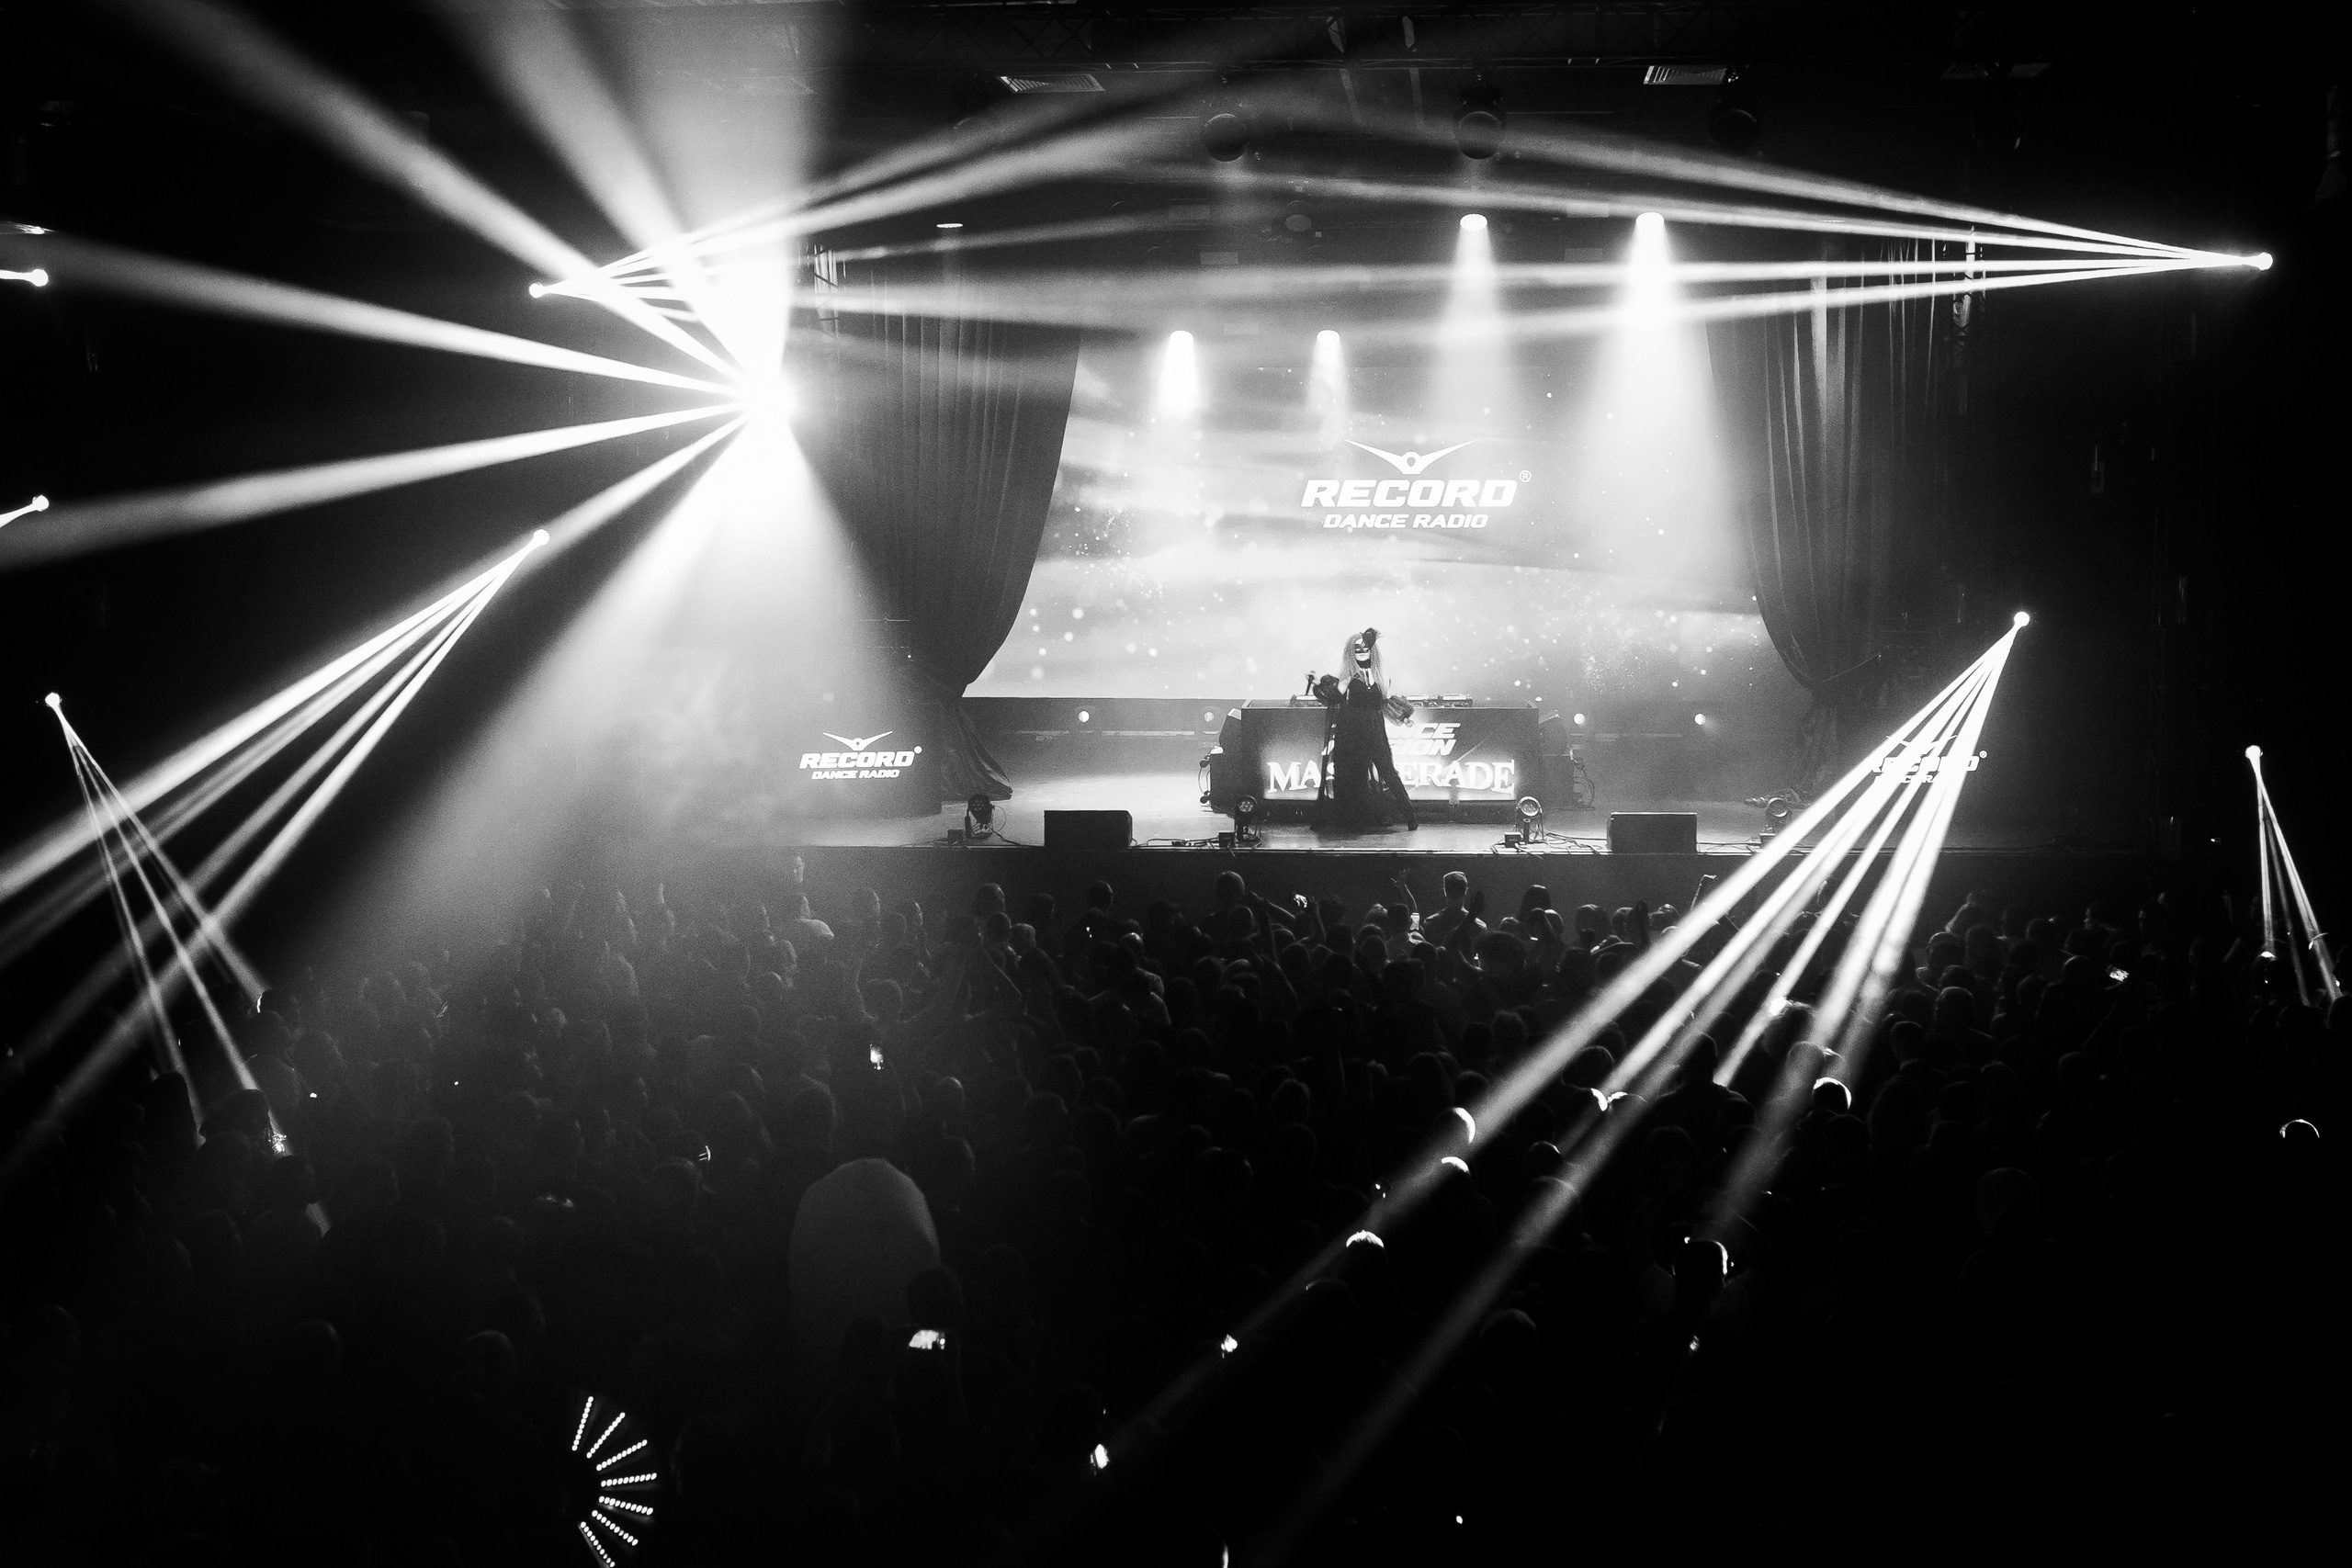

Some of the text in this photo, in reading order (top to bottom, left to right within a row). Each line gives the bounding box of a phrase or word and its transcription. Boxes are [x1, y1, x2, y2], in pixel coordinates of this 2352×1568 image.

[1300, 479, 1518, 507] RECORD
[1323, 513, 1490, 528] DANCE RADIO
[799, 750, 915, 769] RECORD
[811, 769, 900, 780] DANCE RADIO
[1266, 759, 1515, 797] MAERADE
